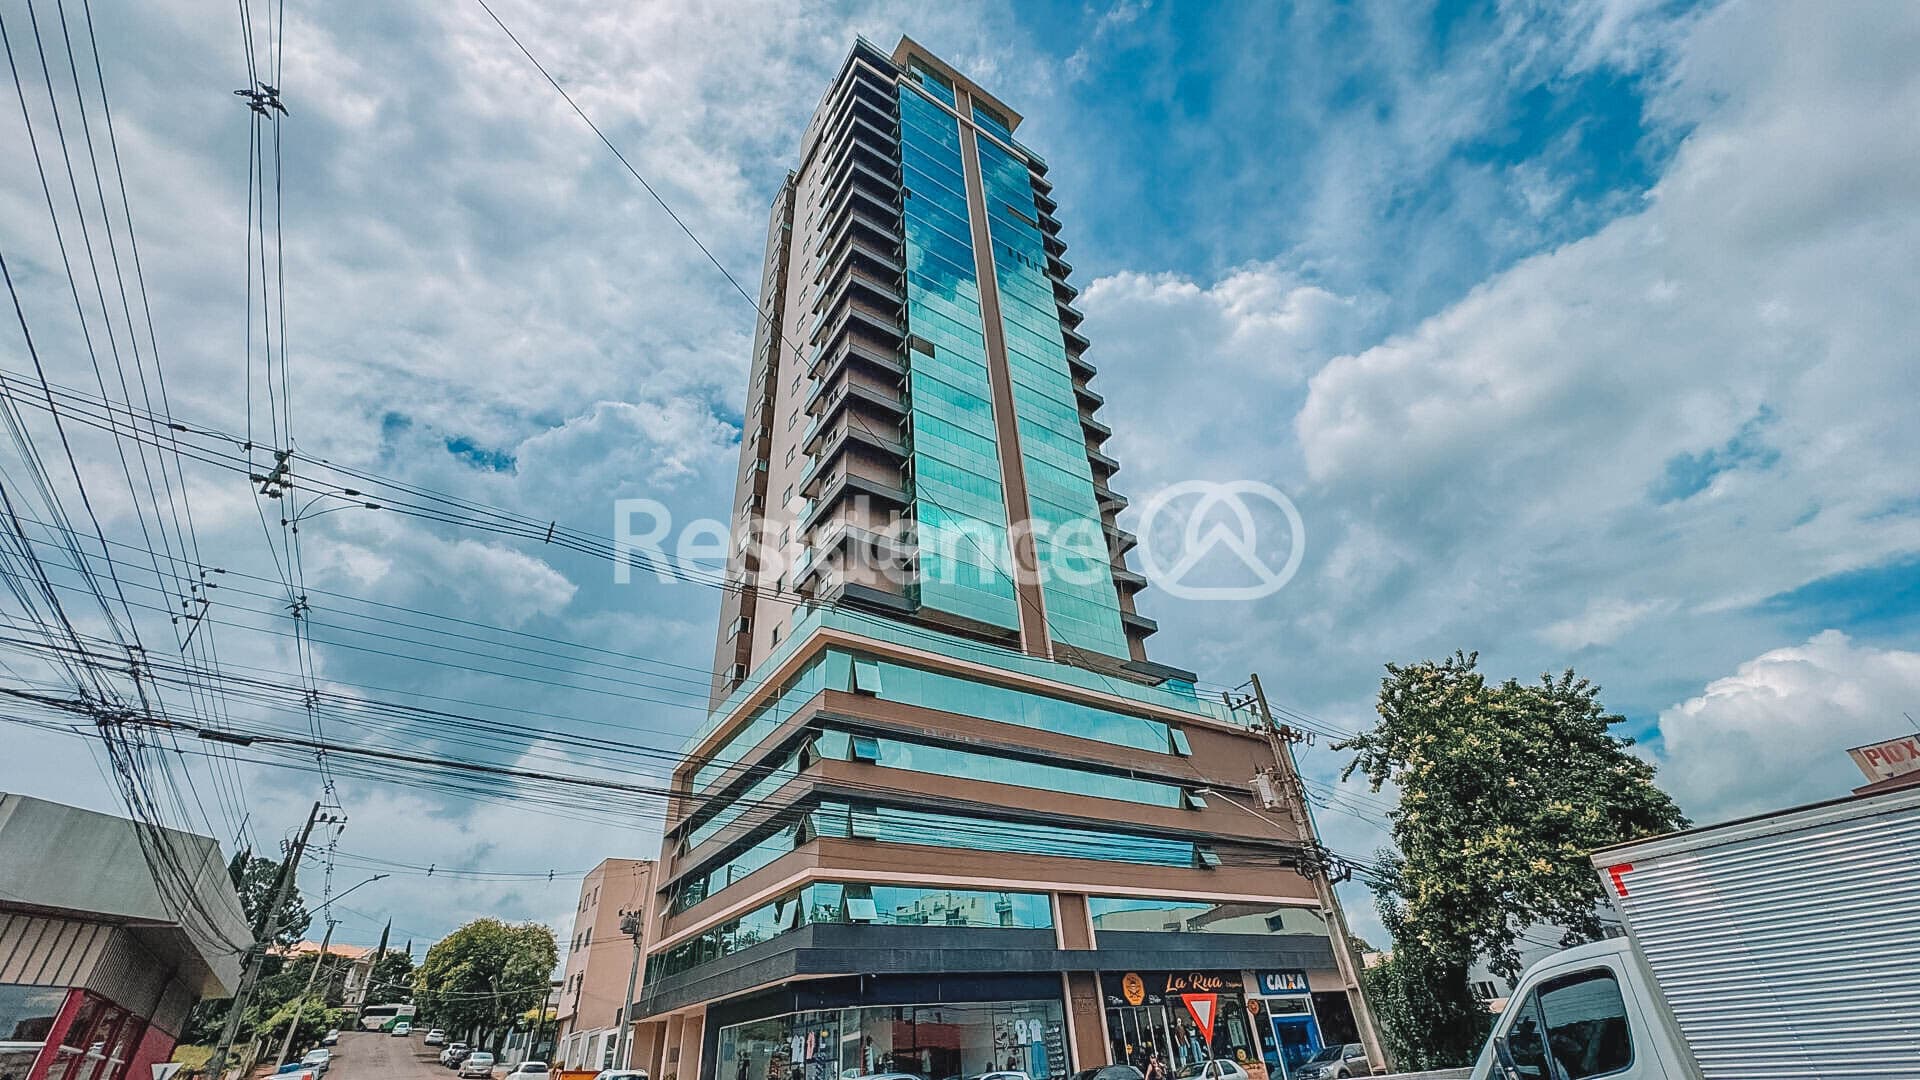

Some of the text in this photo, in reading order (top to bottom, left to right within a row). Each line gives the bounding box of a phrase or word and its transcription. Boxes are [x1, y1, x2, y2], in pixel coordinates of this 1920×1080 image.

[1165, 973, 1187, 992] La
[1188, 972, 1222, 992] Rua
[1266, 974, 1306, 990] CAIXA
